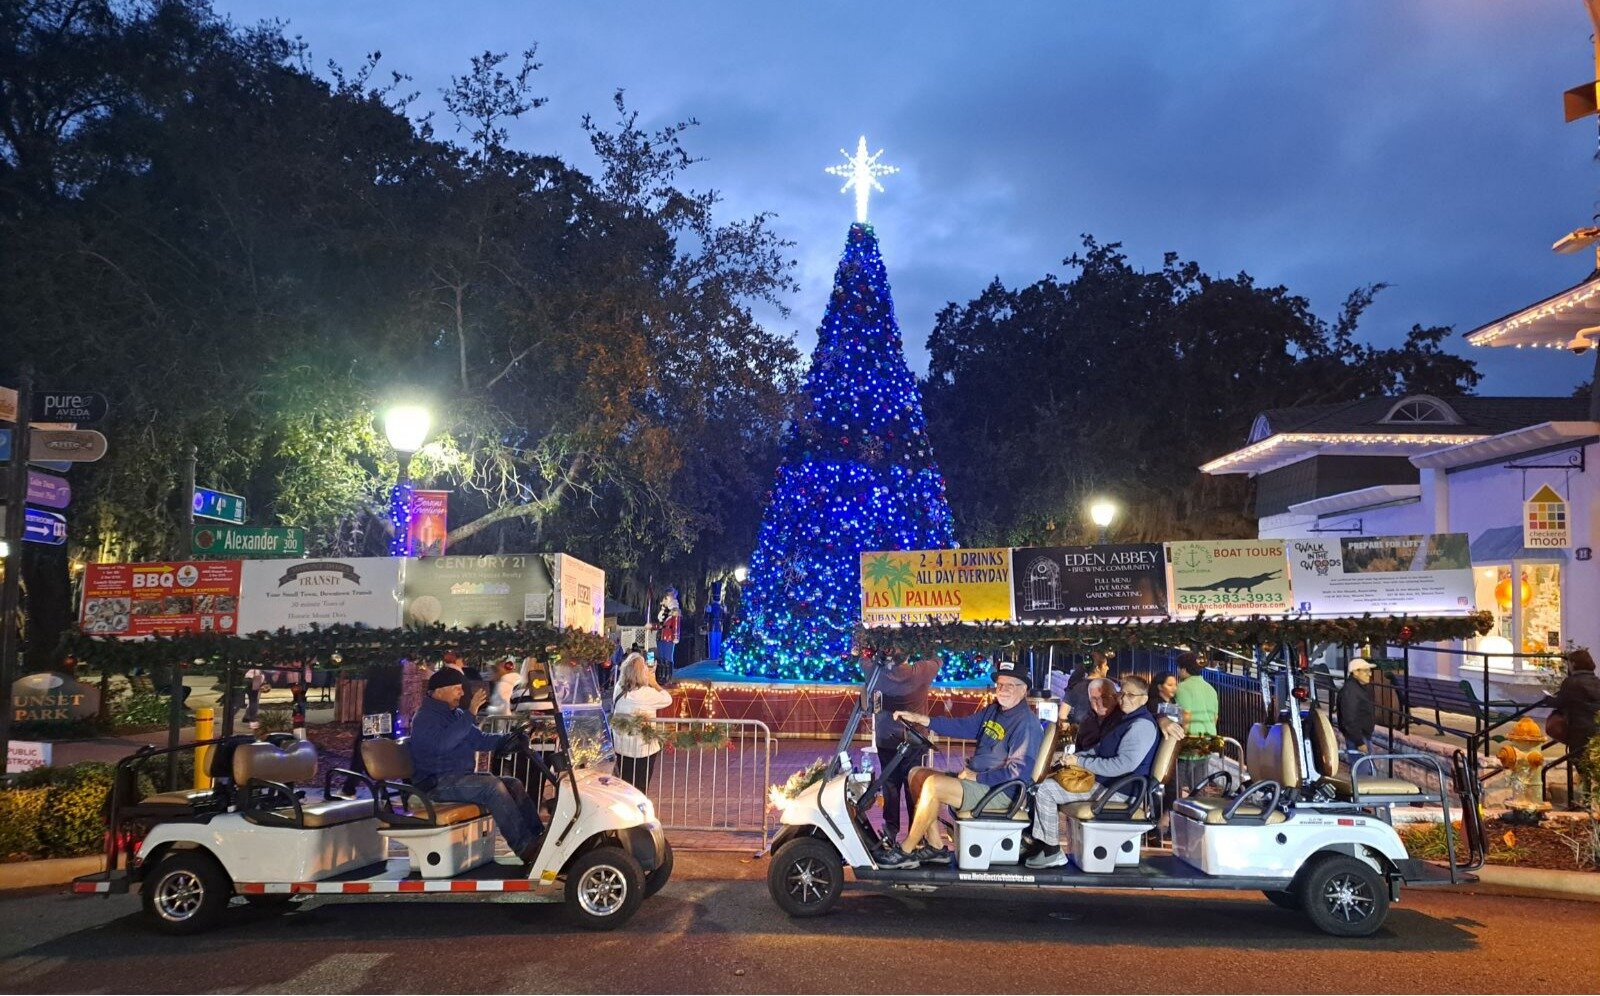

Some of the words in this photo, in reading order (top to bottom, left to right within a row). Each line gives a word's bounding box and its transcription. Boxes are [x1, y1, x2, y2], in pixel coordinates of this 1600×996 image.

[44, 395, 82, 416] pure
[56, 408, 90, 416] AVEDA
[287, 529, 294, 539] St
[216, 530, 222, 540] N
[224, 530, 279, 550] Alexander
[284, 540, 297, 549] 300
[1348, 541, 1383, 549] PREPARE
[1530, 538, 1567, 546] moon
[1213, 549, 1242, 558] BOAT
[1246, 547, 1283, 557] TOURS
[1295, 543, 1325, 553] WALK
[961, 552, 1004, 566] DRINKS
[1065, 553, 1105, 566] EDEN
[1110, 551, 1159, 564] ABBEY
[1314, 551, 1329, 559] THE
[435, 557, 507, 569] CENTURY
[512, 557, 526, 568] 21
[1106, 564, 1151, 572] COMMUNITY
[1300, 559, 1341, 570] WOODS
[132, 573, 174, 588] BBQ
[299, 575, 341, 586] TRANSIT
[916, 570, 933, 585] ALL
[936, 569, 955, 584] DAY
[958, 568, 1009, 584] EVERYDAY
[865, 591, 890, 608] LAS
[906, 590, 962, 606] PALMAS
[1180, 593, 1283, 604] 352-383-3933
[1177, 602, 1286, 611] RustyAnchorMountDora.com
[901, 613, 961, 622] RESTARANT
[14, 694, 85, 707] UNSET
[15, 709, 68, 721] PARK
[8, 748, 37, 757] PUBLIC
[7, 758, 46, 766] STROOM
